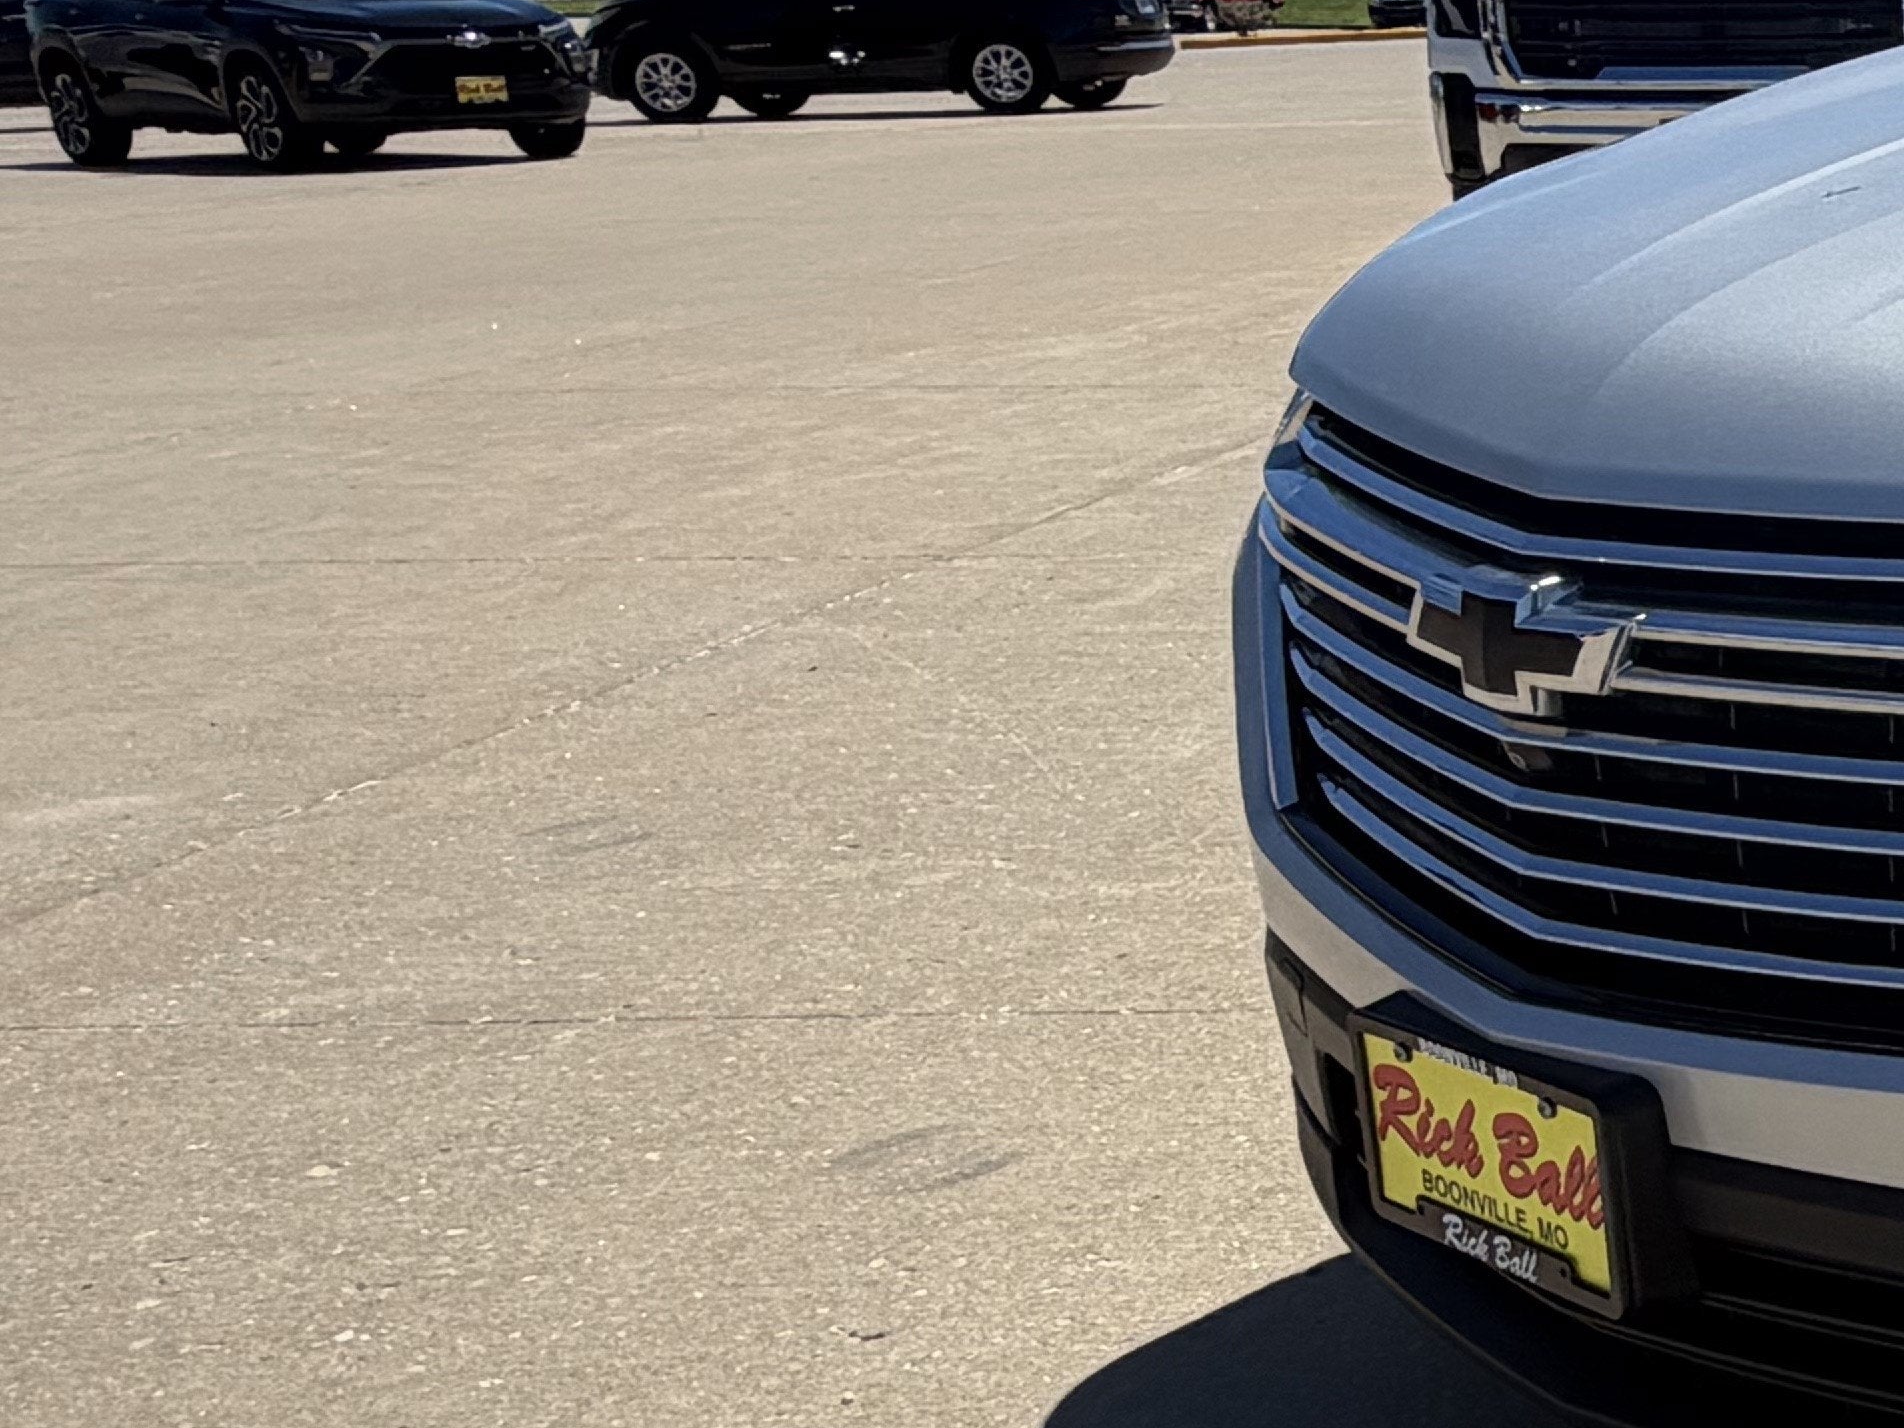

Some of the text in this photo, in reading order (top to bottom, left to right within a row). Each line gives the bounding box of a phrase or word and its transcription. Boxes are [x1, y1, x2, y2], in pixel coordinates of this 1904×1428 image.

[1372, 1064, 1605, 1230] Rick Ball
[1442, 1213, 1538, 1283] Rick Ball
[1537, 1216, 1568, 1250] MO
